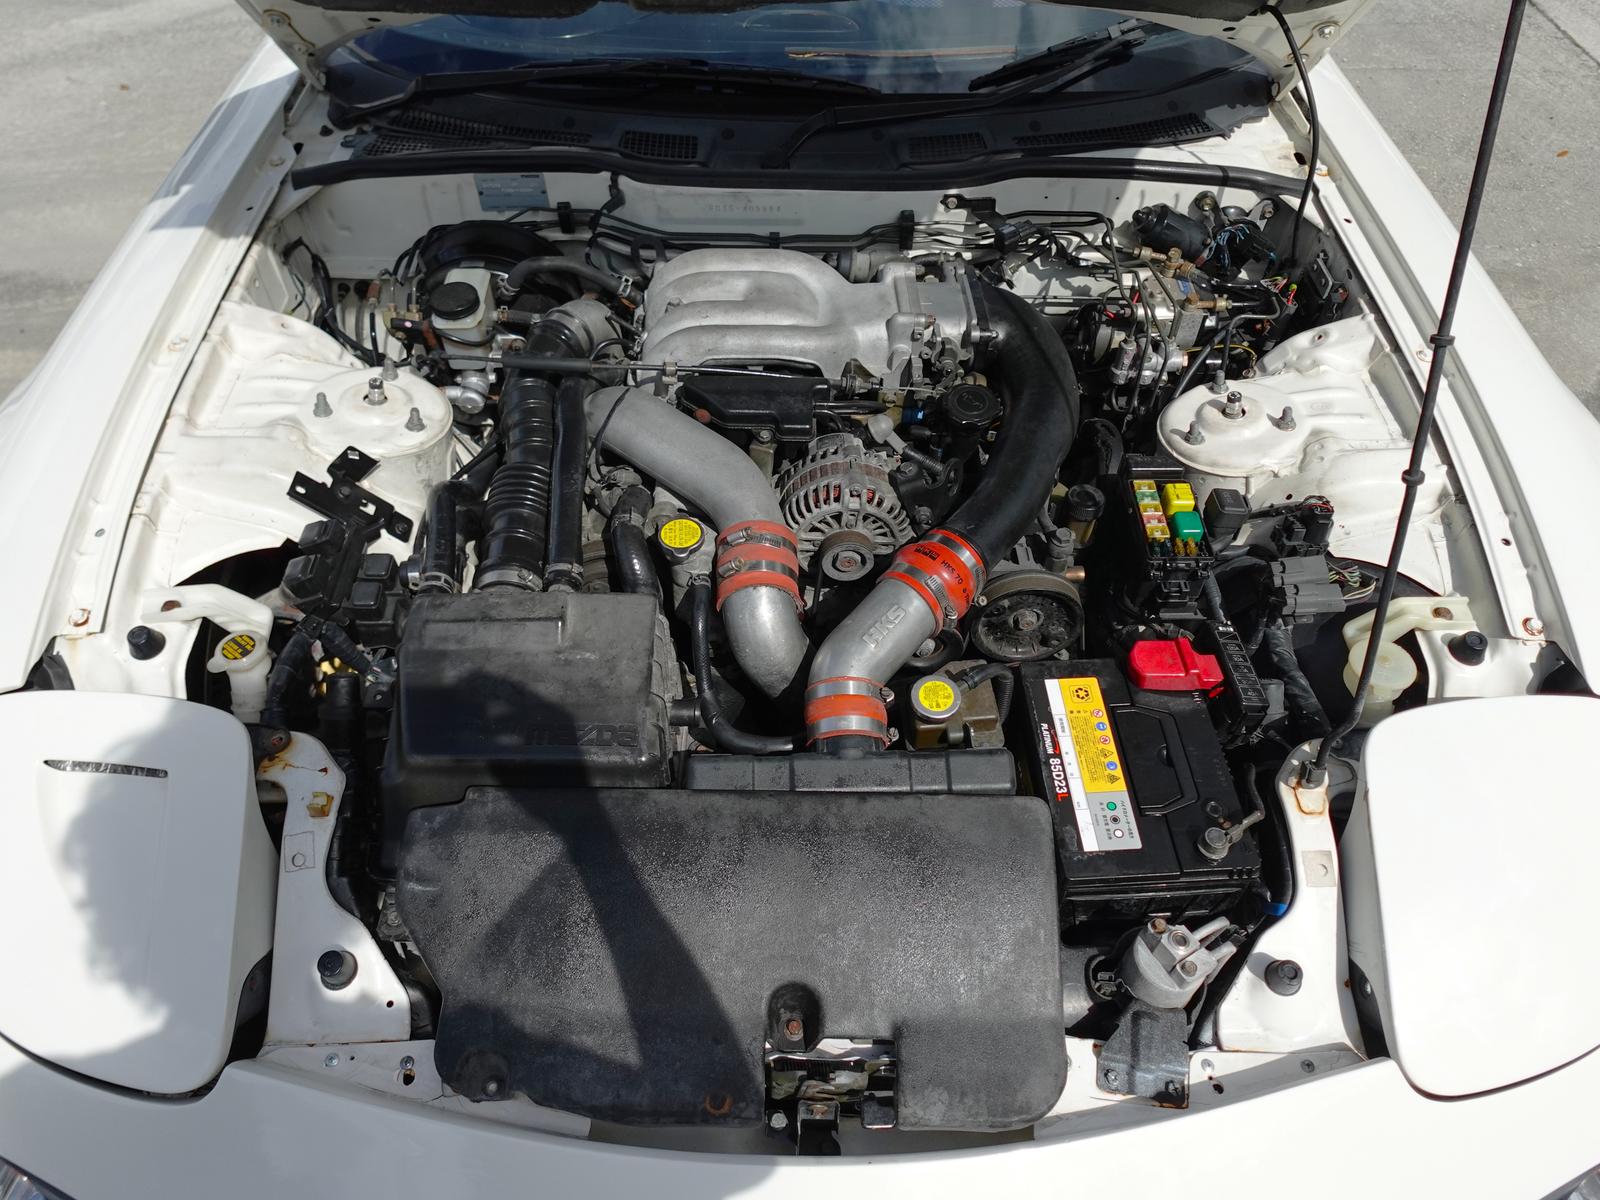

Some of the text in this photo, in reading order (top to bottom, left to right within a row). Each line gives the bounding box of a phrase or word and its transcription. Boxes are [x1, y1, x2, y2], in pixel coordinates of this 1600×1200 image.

[940, 560, 956, 574] HKS
[862, 605, 907, 648] HKS
[1040, 723, 1055, 755] PLATINUM
[1049, 758, 1070, 801] 85D23L
